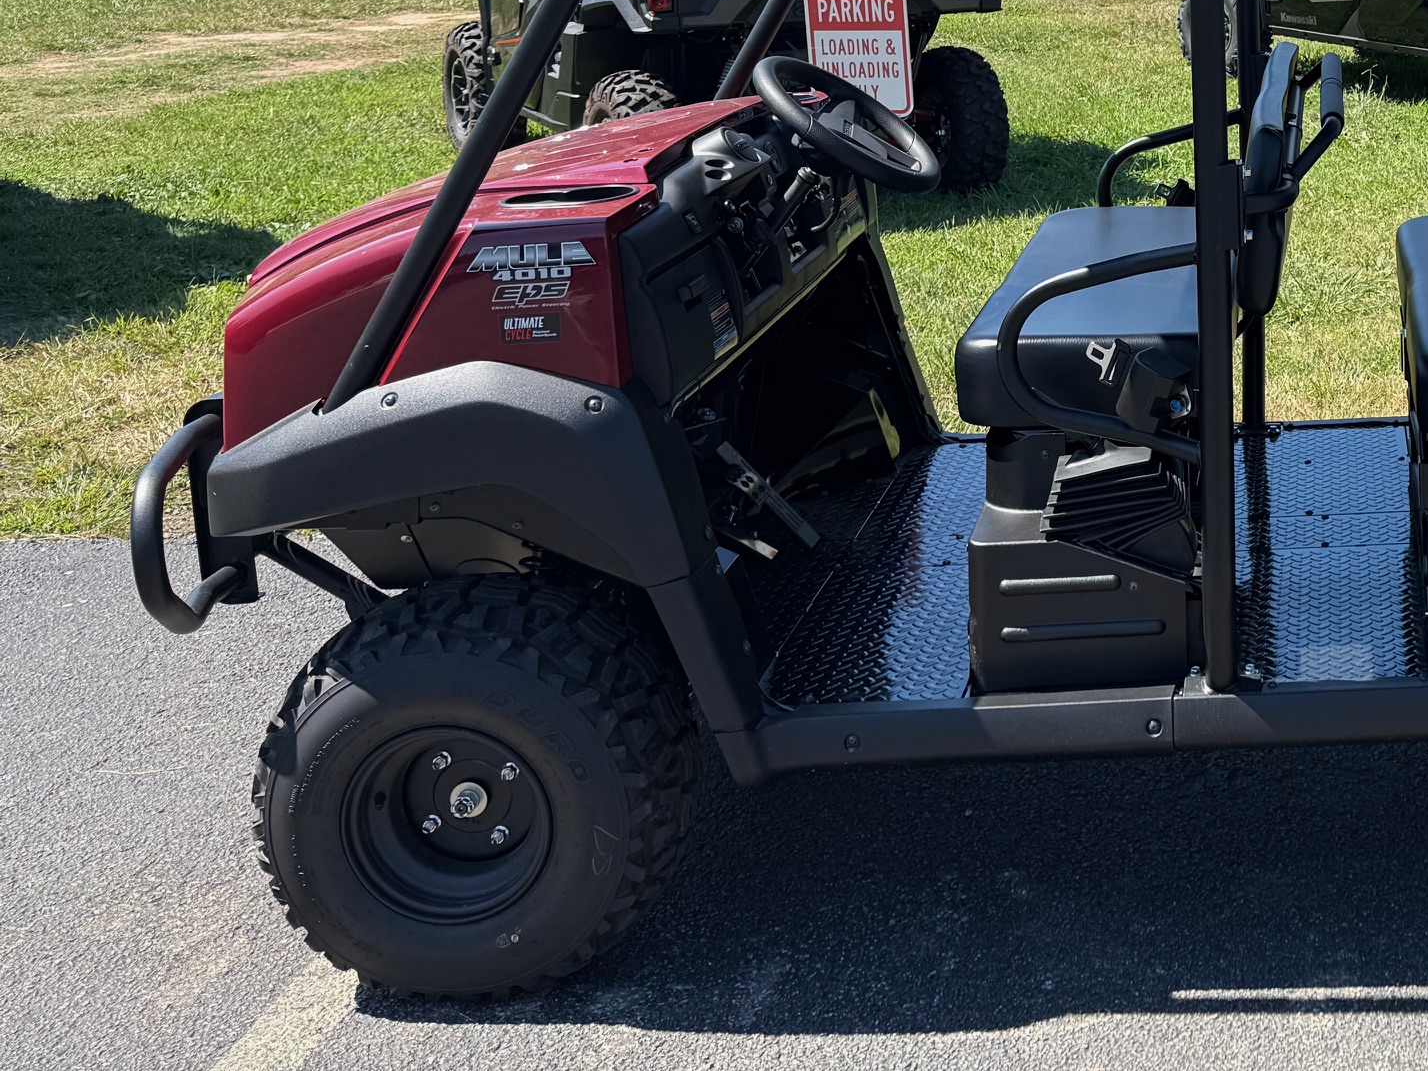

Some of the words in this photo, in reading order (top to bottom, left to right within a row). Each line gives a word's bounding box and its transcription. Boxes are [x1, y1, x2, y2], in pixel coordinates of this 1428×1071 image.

[1281, 12, 1317, 26] Kawasaki
[821, 38, 879, 55] LOADING
[886, 39, 896, 55] &
[466, 241, 596, 273] MULE
[492, 267, 571, 281] 4010
[492, 281, 570, 305] EPS
[504, 316, 544, 330] ULTIMATE
[505, 329, 532, 341] CYCLE
[481, 688, 592, 784] DURO
